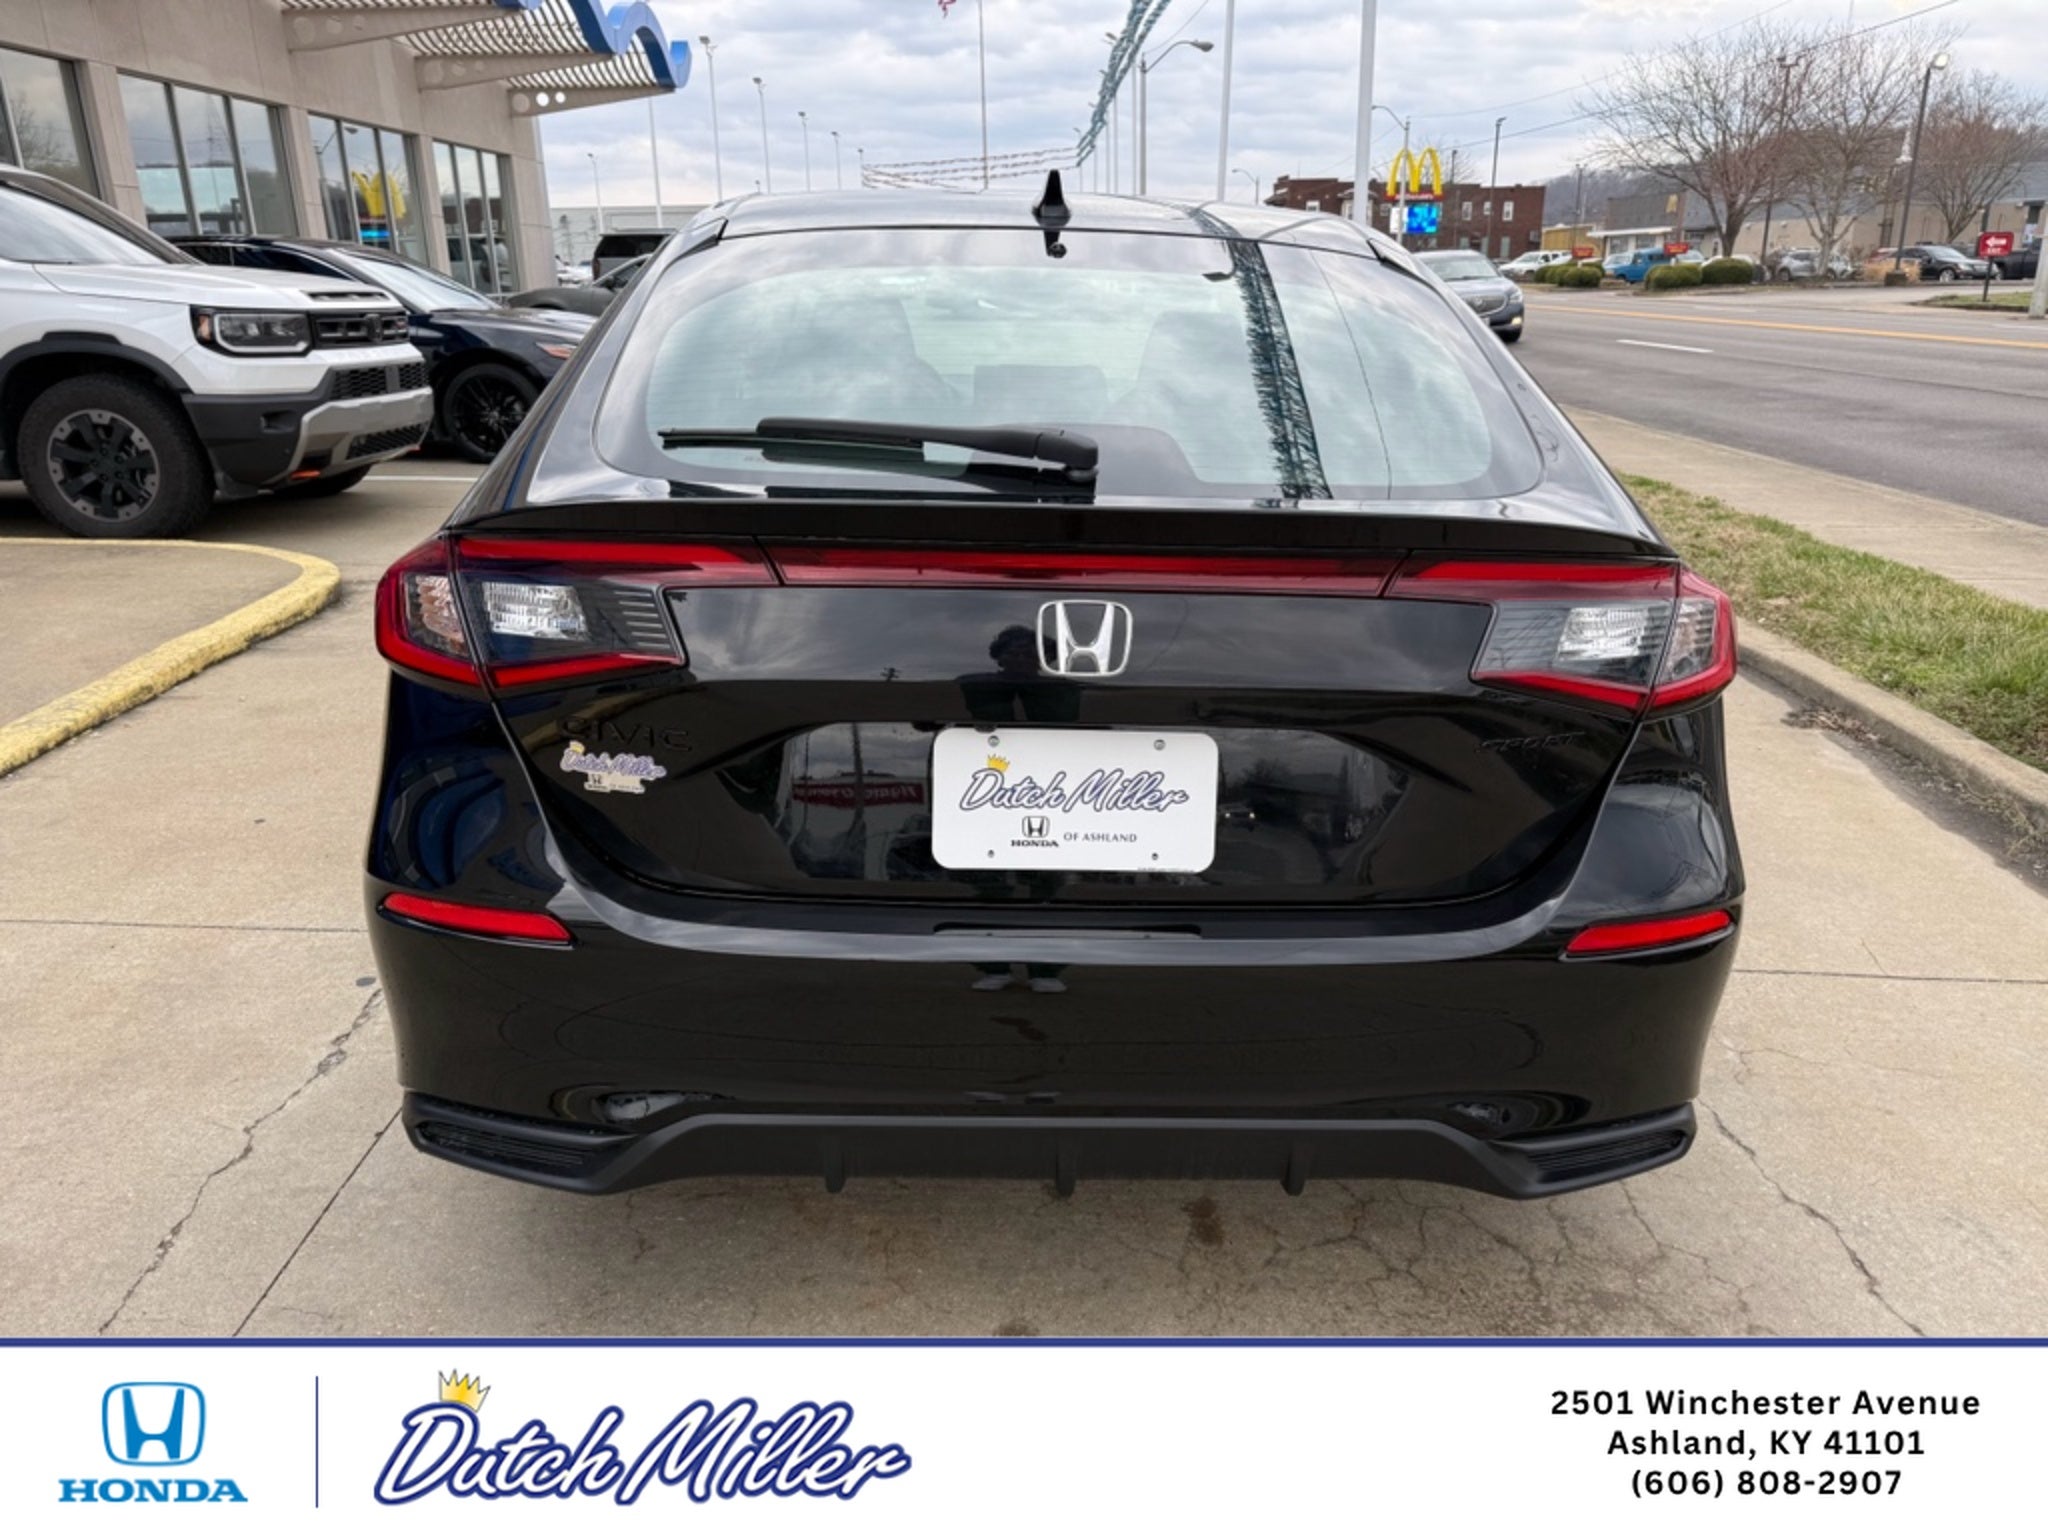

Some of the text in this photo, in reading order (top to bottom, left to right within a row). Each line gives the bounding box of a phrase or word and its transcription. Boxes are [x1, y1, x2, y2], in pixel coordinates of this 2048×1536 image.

[561, 716, 693, 752] CIVIC
[959, 767, 1189, 813] Dutch Miller
[1010, 839, 1060, 848] HONDA
[1063, 831, 1137, 843] OF ASHLAND
